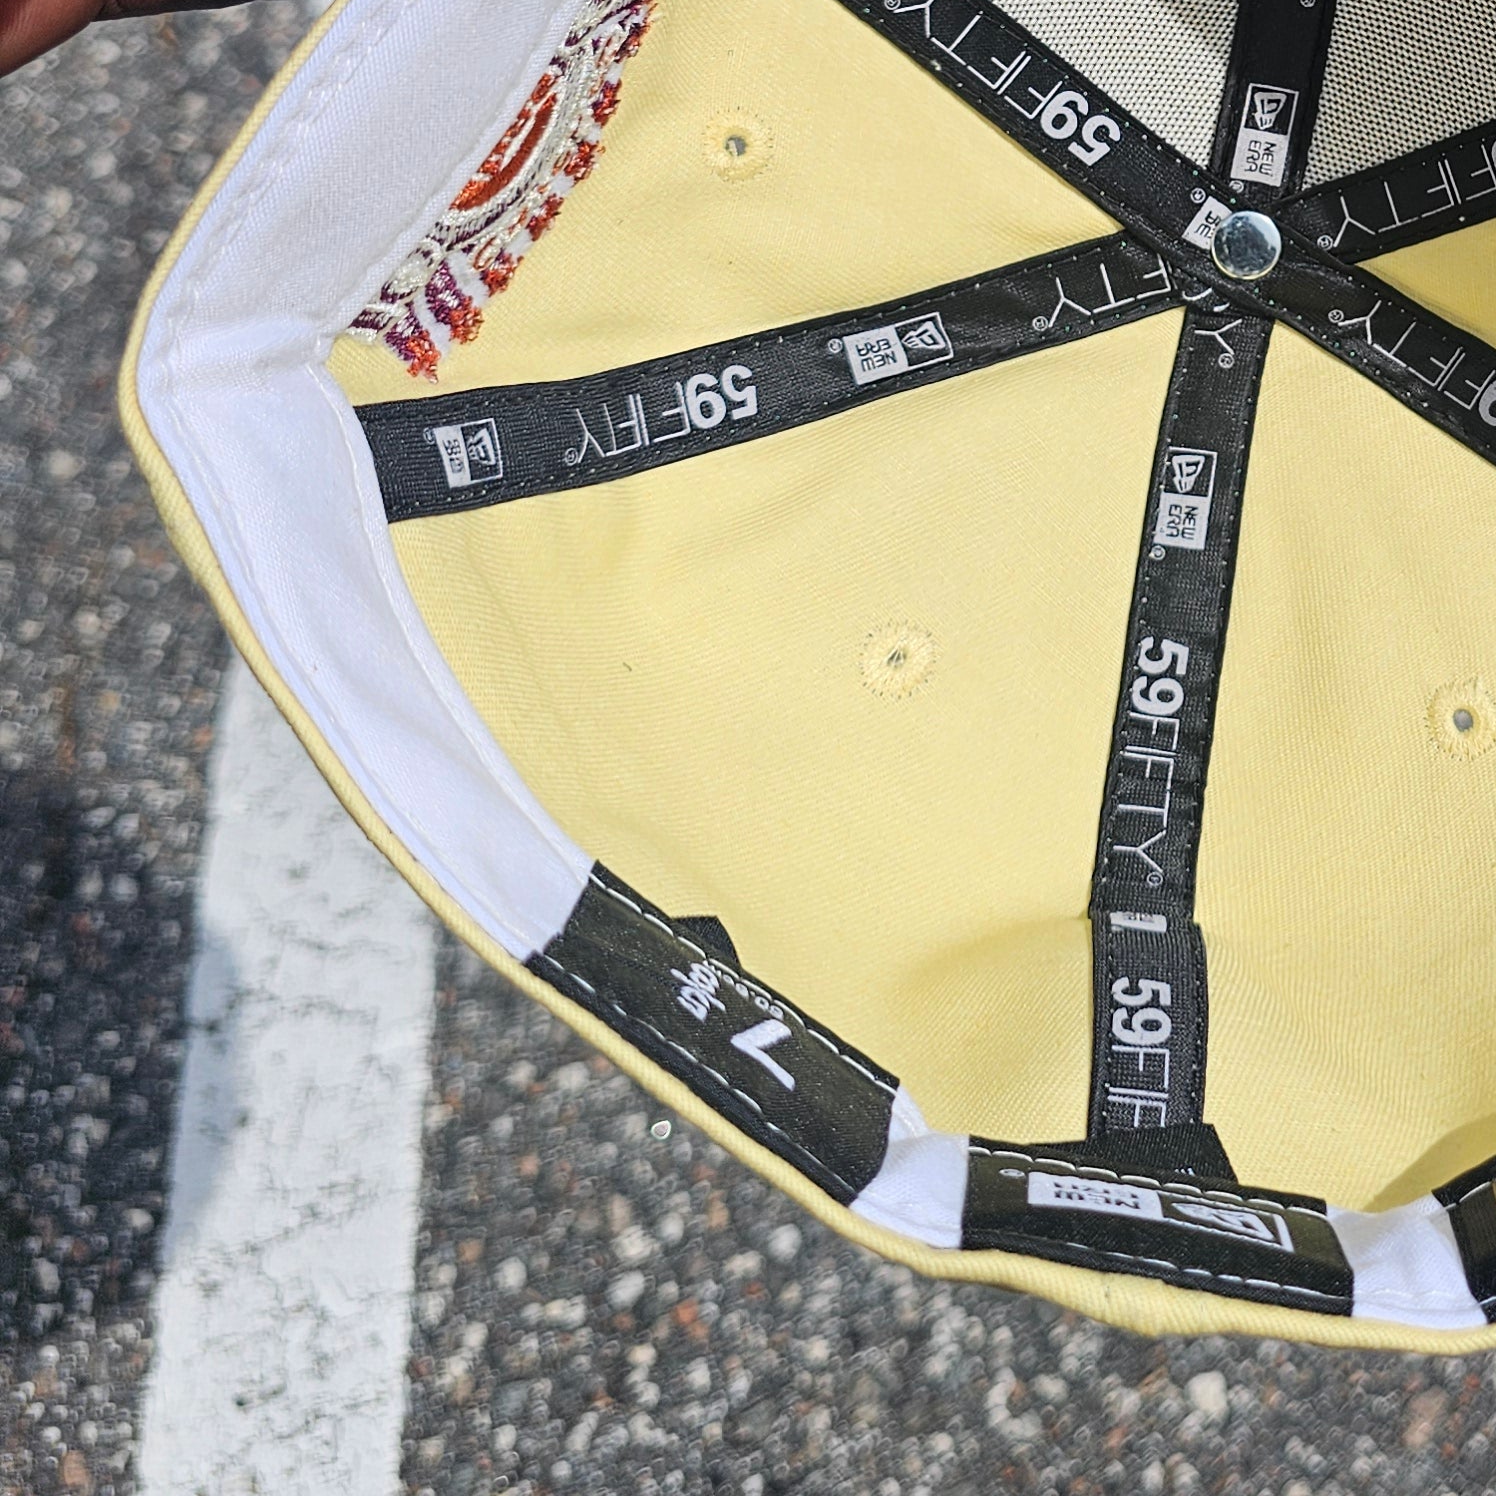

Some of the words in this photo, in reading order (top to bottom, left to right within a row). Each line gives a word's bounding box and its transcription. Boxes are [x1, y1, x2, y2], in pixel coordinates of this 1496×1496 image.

[1243, 139, 1261, 173] ERA
[1257, 140, 1277, 177] NEW
[856, 337, 891, 356] ERA
[860, 349, 898, 373] NEW
[1165, 503, 1180, 538] ERA
[1180, 504, 1200, 541] NEW
[729, 1017, 797, 1093] 7
